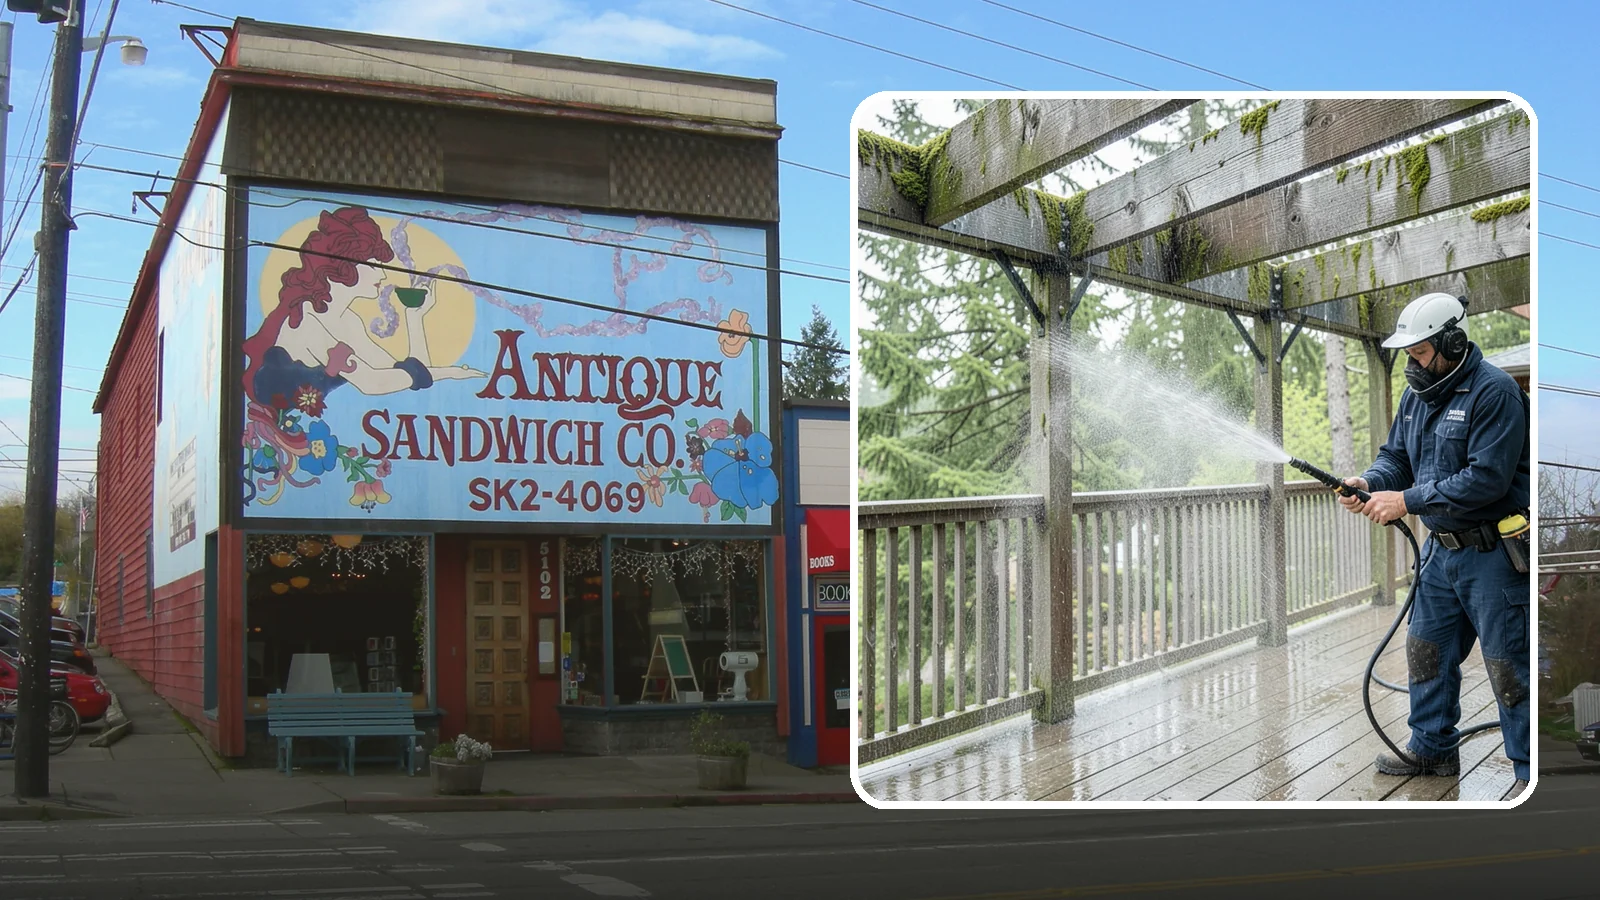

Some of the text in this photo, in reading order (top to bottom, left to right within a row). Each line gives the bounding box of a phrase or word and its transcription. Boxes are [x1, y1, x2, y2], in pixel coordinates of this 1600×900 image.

[476, 329, 723, 420] ANTIQUE
[362, 409, 685, 468] SANDWICH CO.
[468, 477, 646, 512] SK2-4069
[540, 541, 551, 599] 5102
[809, 555, 835, 569] BOOKS
